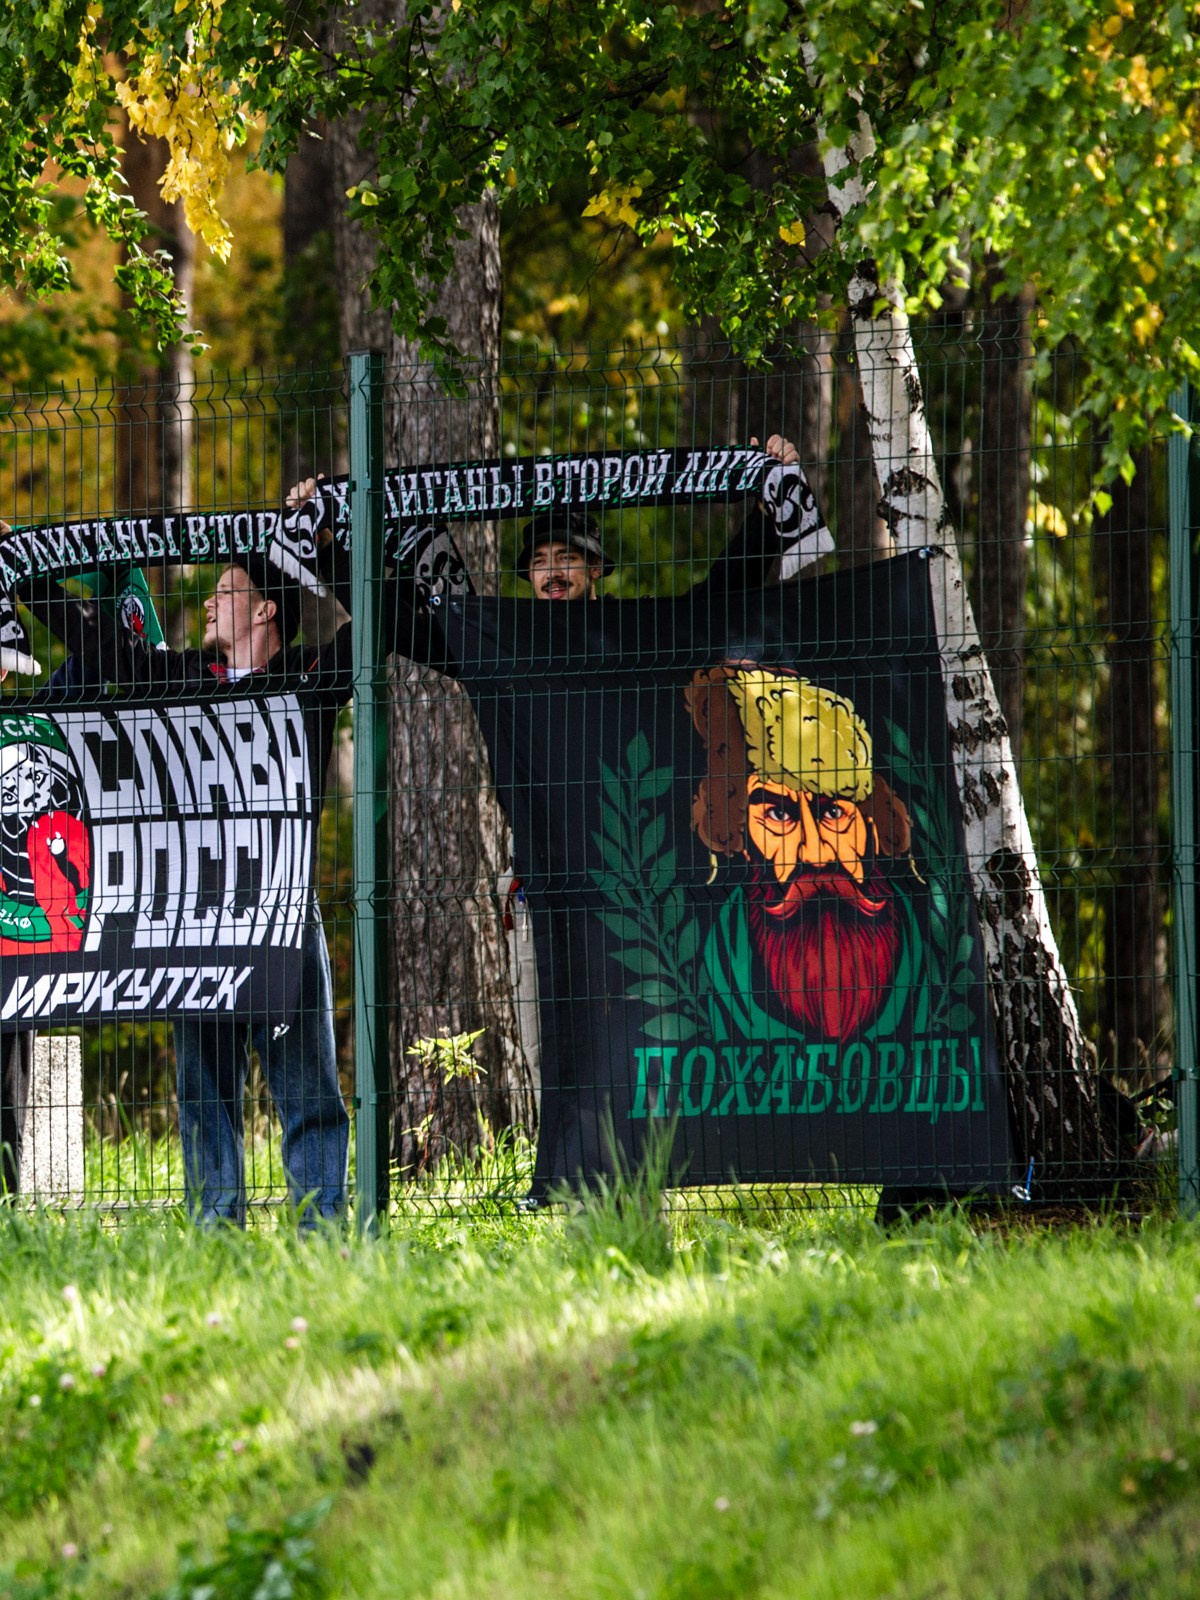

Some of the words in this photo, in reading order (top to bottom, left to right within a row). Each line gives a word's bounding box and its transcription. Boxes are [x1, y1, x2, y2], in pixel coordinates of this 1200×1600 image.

[323, 465, 524, 523] ХЛИГАНЫ
[534, 449, 671, 505] ВТОРОЙ
[186, 512, 278, 553] ВТОР
[51, 694, 312, 819] СЛАВА
[84, 818, 312, 952] РОССИИ
[627, 1037, 986, 1125] ПОХАБОВЦЫ
